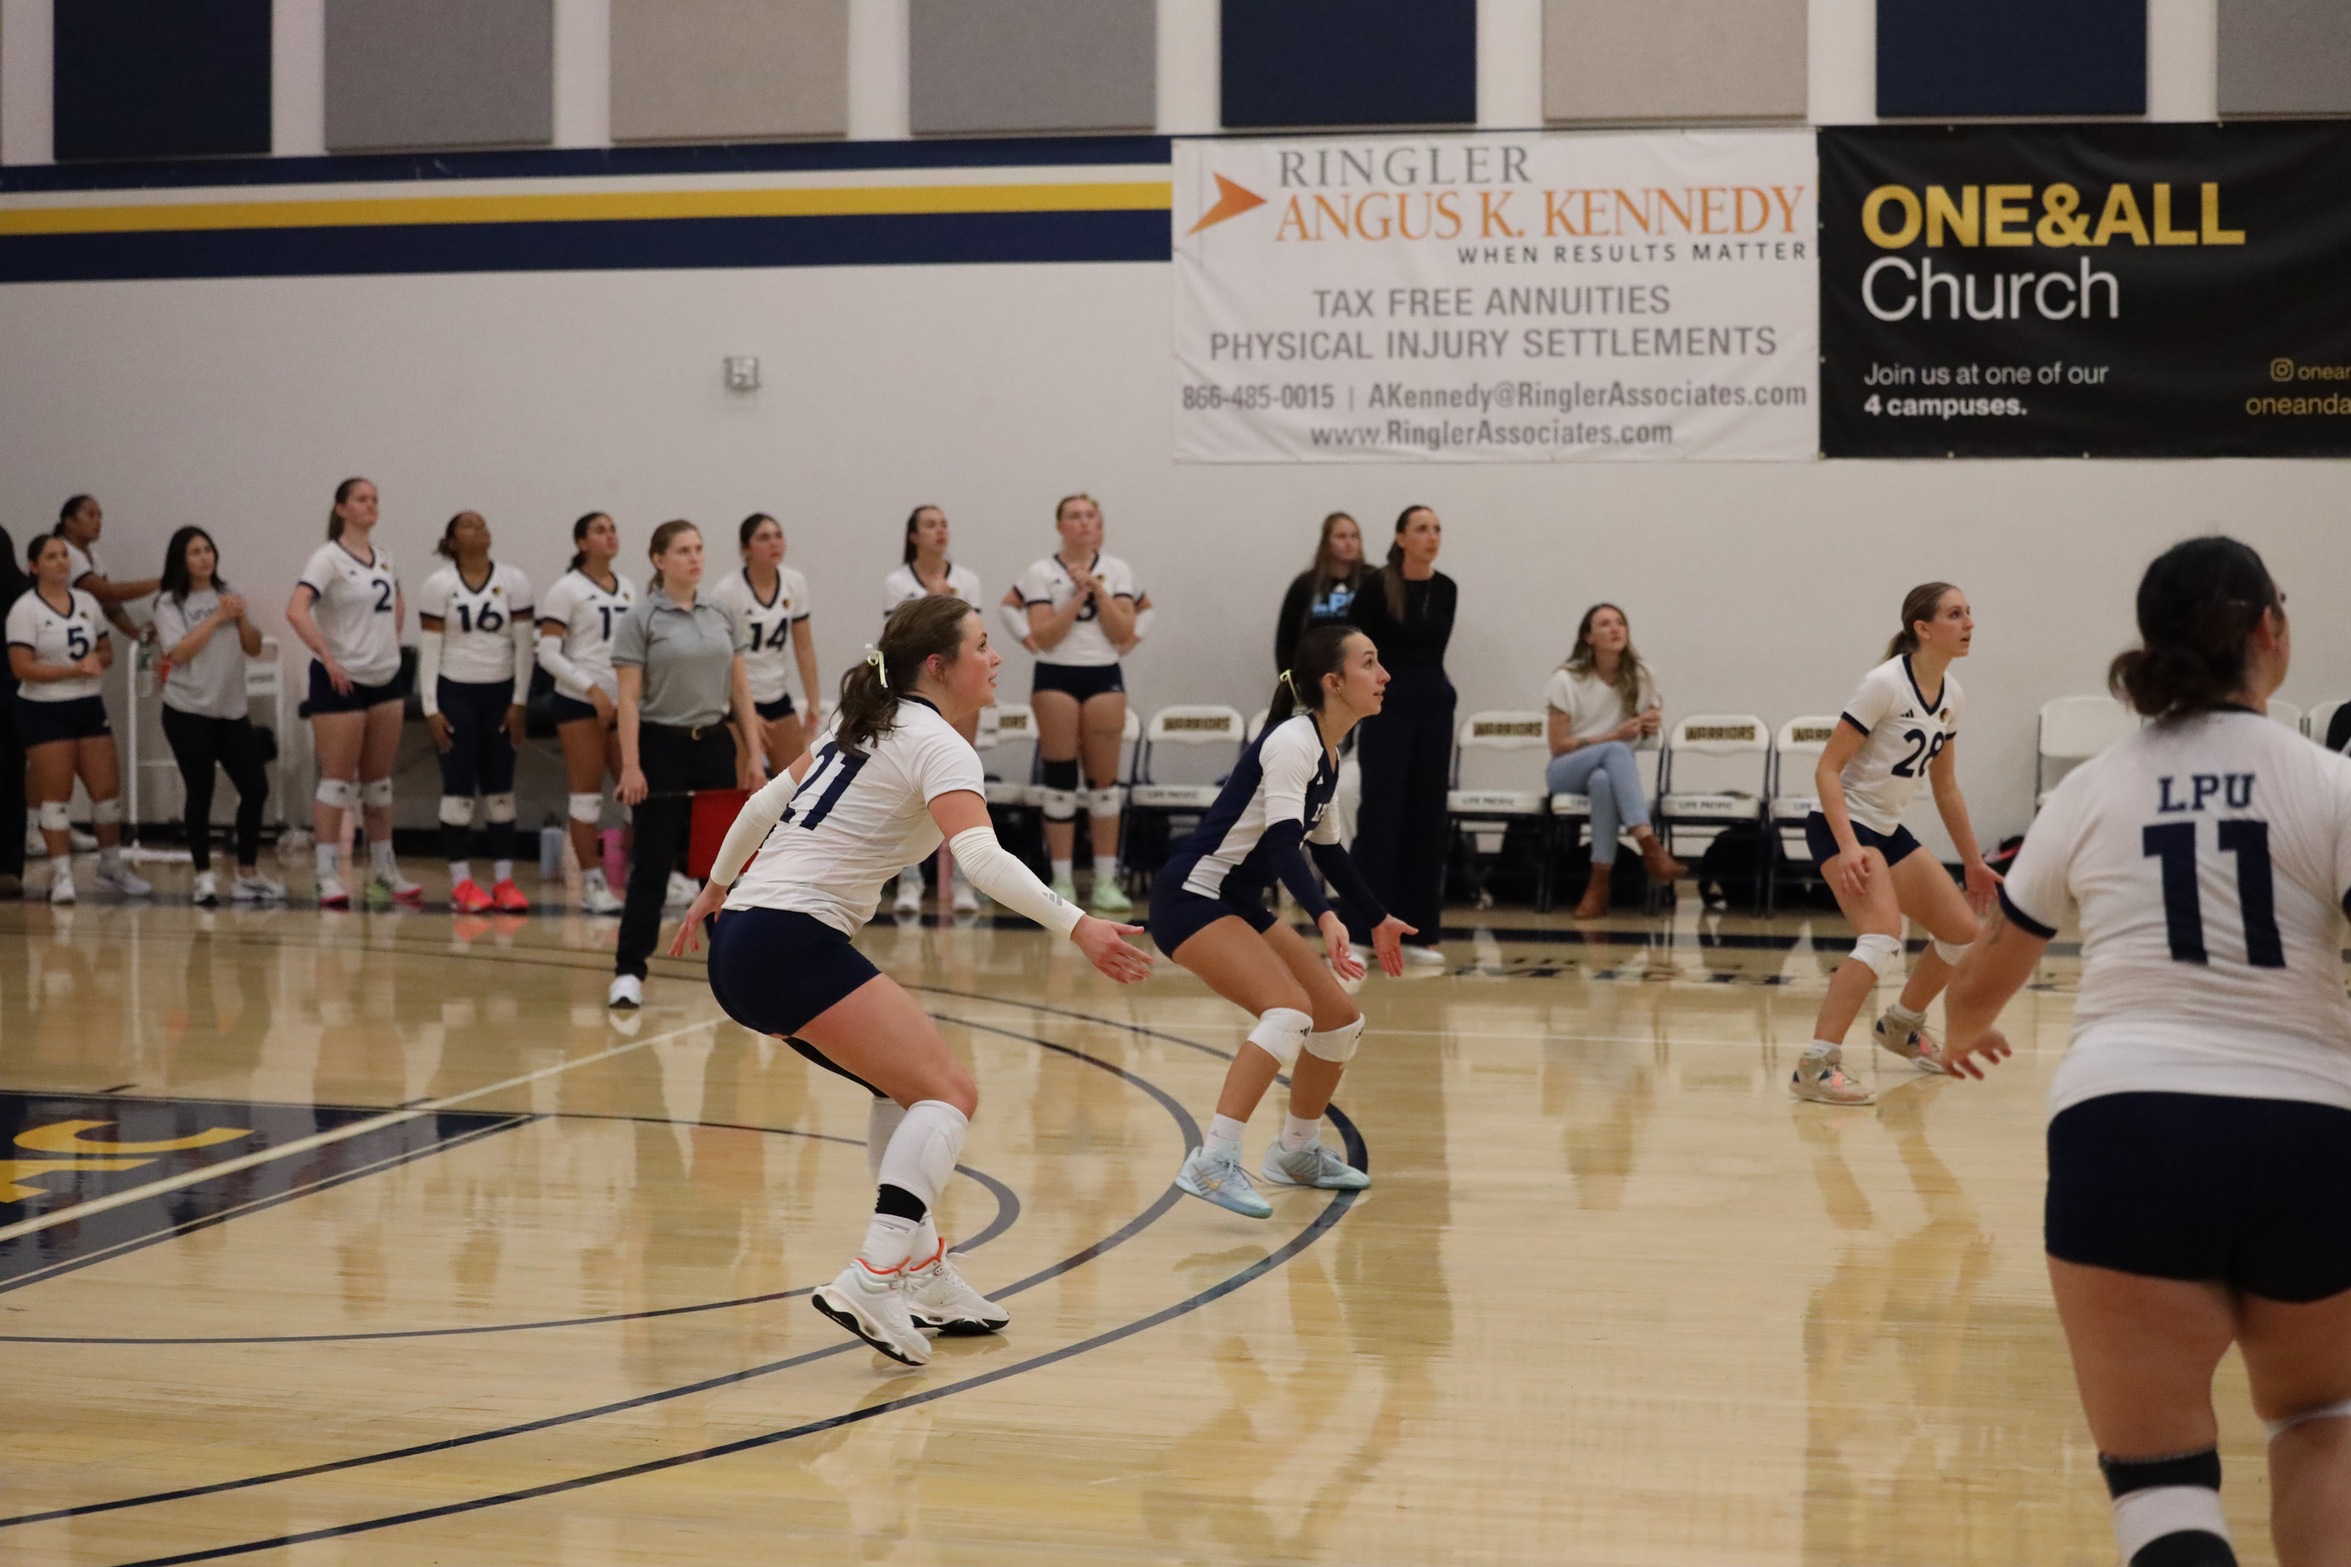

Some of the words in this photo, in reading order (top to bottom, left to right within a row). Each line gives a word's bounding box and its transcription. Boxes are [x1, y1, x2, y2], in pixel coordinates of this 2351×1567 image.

[1279, 146, 1532, 188] RINGLER
[1275, 190, 1463, 242] ANGUS
[1480, 188, 1525, 239] K.
[1542, 185, 1806, 238] KENNEDY
[1861, 182, 2246, 249] ONE&ALL
[1457, 244, 1538, 265] WHEN
[1555, 242, 1676, 264] RESULTS
[1693, 241, 1807, 262] MATTER
[1313, 289, 1375, 318] TAX
[1390, 287, 1473, 317] FREE
[1485, 285, 1670, 316] ANNUITIES
[1861, 256, 2119, 322] Church
[1210, 330, 1374, 361] PHYSICAL
[1388, 328, 1508, 359] INJURY
[1524, 326, 1777, 358] SETTLEMENTS
[1863, 362, 1915, 386] Join
[1922, 367, 1950, 386] us
[1956, 364, 1980, 386] at
[1985, 367, 2032, 386] one
[2037, 361, 2063, 385] of
[2067, 366, 2109, 385] our
[1183, 384, 1334, 410] 866-485-0015
[1368, 380, 1808, 413] AKennedy@RinglerAssociates.com
[1863, 395, 1881, 417] 4
[1887, 396, 2028, 420] campuses.
[1310, 418, 1674, 450] www.RinglerAssociates.com
[371, 579, 392, 612] 2
[457, 602, 503, 632] 16
[67, 627, 89, 661] 5
[750, 618, 787, 651] 14
[1473, 721, 1542, 737] WARRIORS
[1684, 725, 1755, 741] WARRIORS
[2158, 773, 2255, 814] LPU
[2142, 820, 2286, 968] 11
